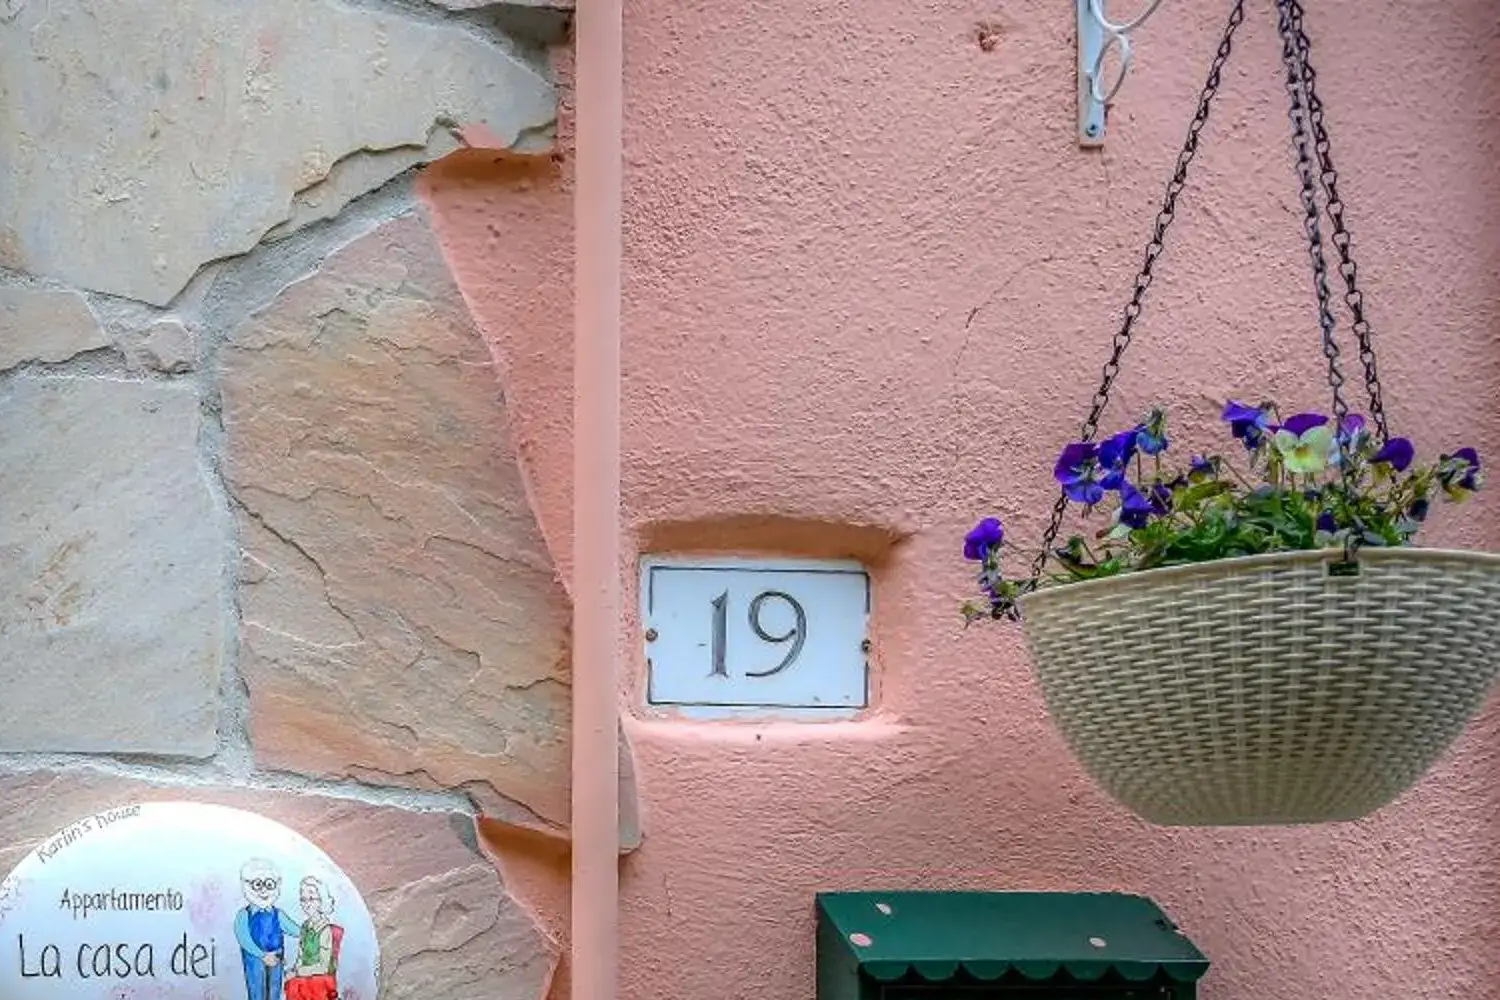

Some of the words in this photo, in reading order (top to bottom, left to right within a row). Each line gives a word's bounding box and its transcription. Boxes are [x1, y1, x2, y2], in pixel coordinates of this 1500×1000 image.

[708, 587, 808, 678] 19
[95, 805, 141, 829] house
[60, 887, 184, 920] Appartamento
[19, 933, 61, 978] La
[77, 943, 155, 979] casa
[171, 931, 216, 979] dei
